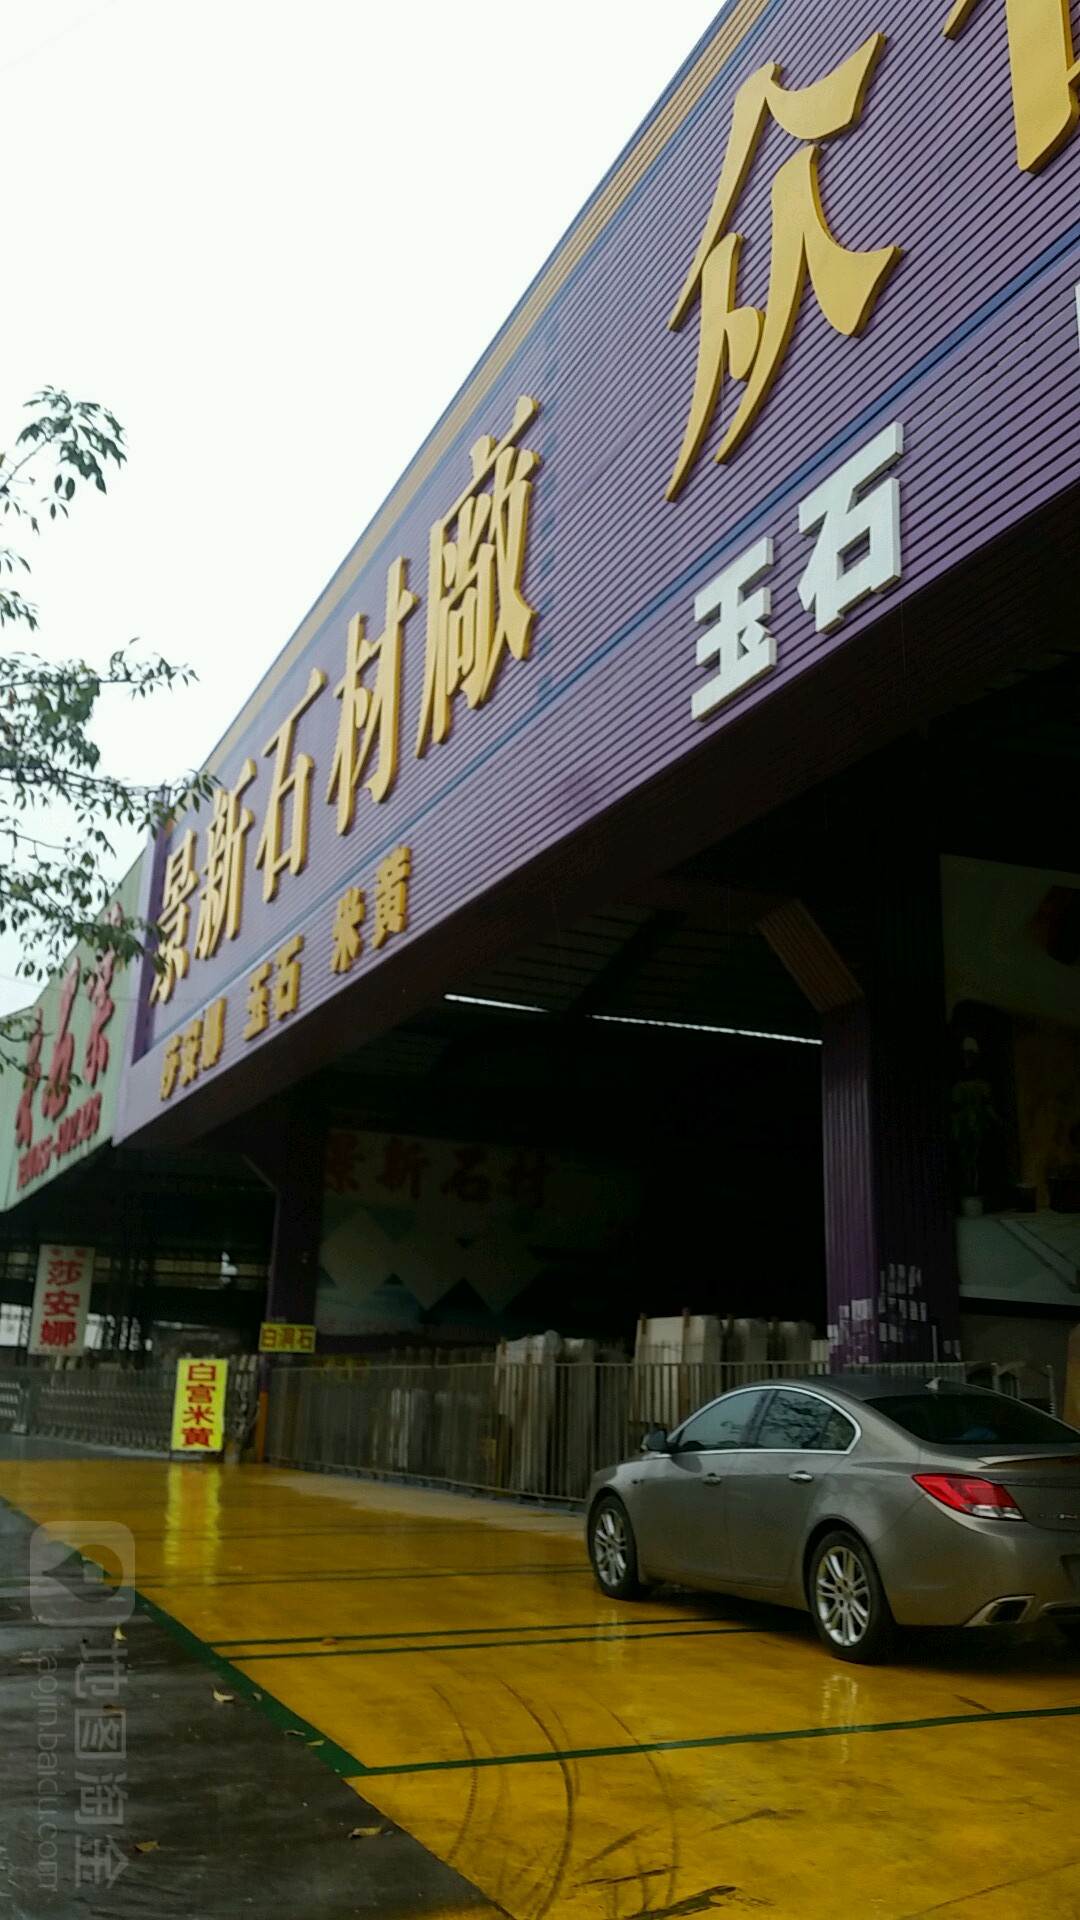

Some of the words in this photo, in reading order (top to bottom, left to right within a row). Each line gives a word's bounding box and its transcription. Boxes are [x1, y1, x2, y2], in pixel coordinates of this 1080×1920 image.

[150, 395, 541, 1005] 景新石材廠
[692, 421, 904, 720] 玉石
[243, 935, 304, 1041] 玉石
